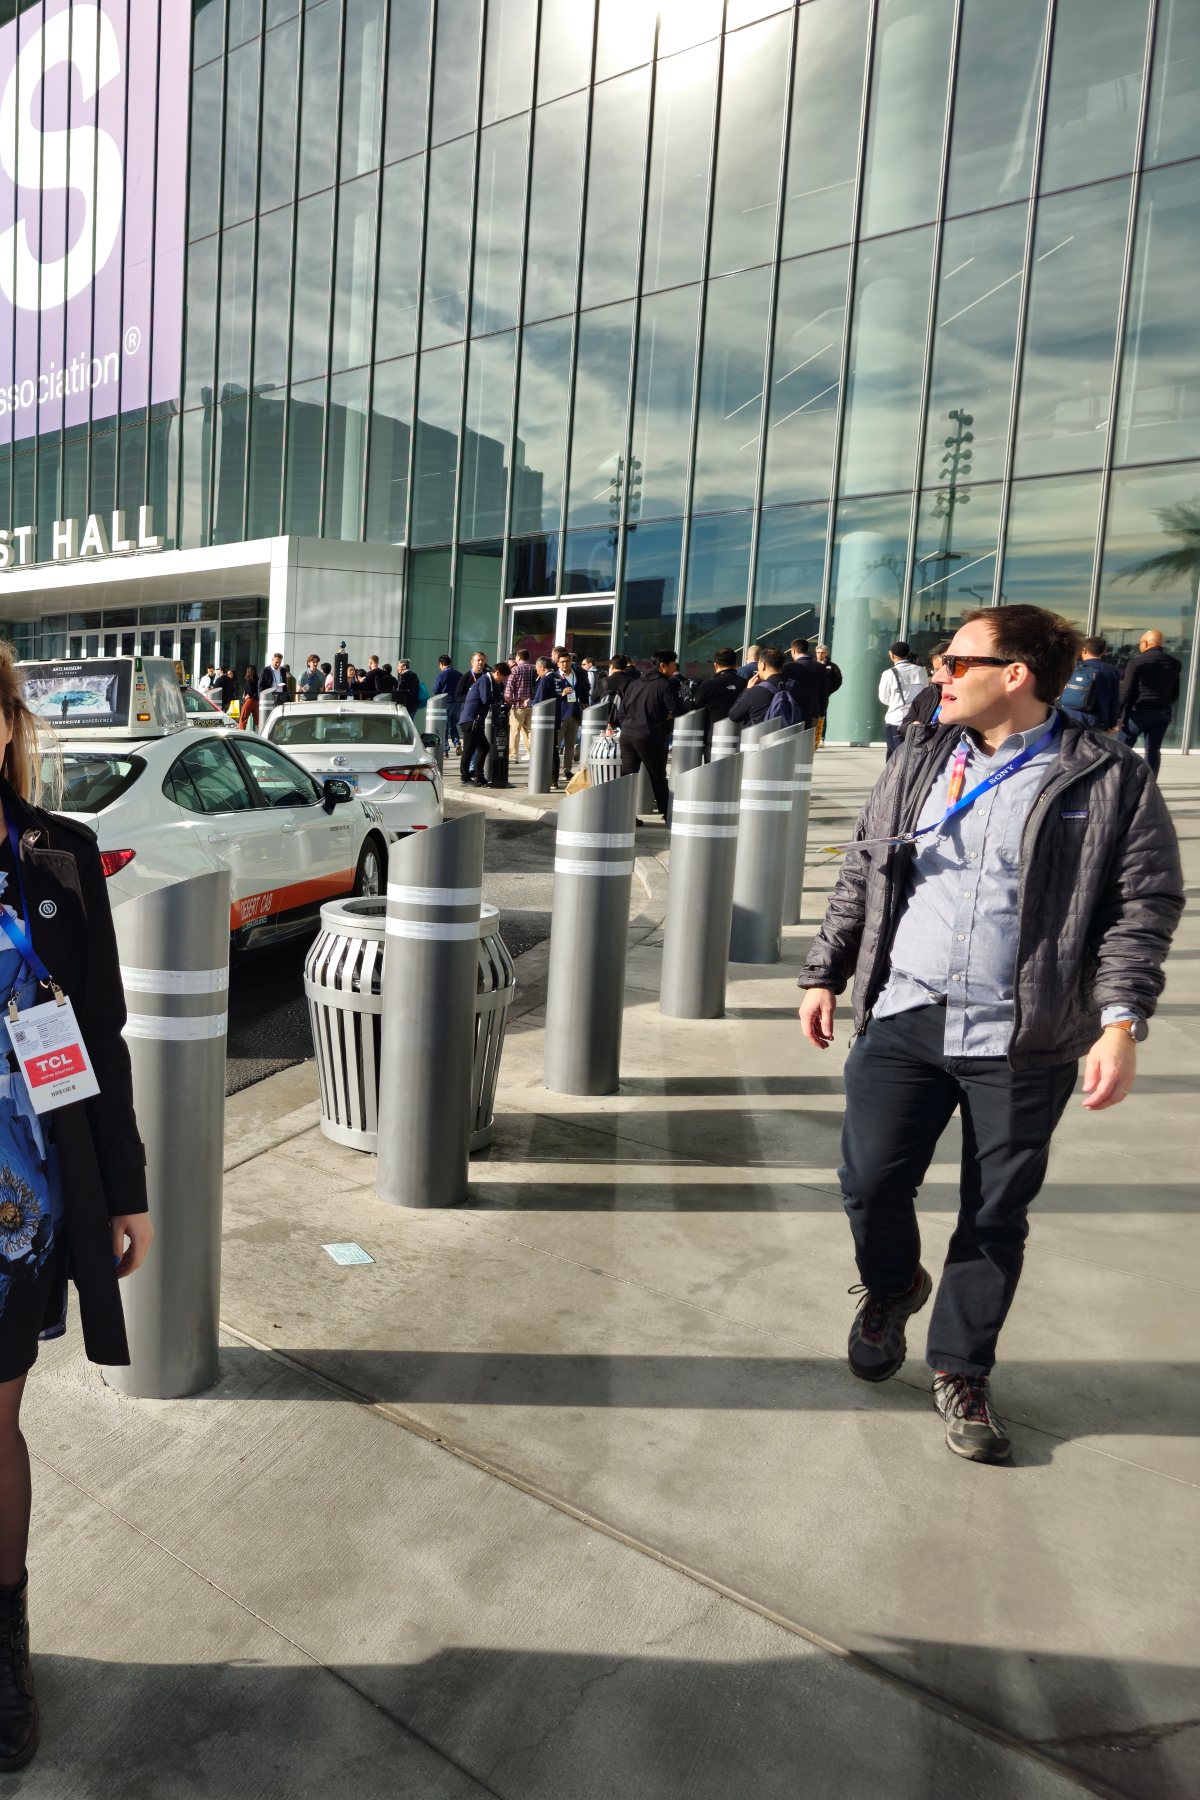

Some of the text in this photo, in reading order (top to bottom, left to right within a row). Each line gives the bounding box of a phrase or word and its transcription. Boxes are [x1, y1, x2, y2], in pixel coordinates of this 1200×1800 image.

[52, 505, 163, 560] HALL
[988, 764, 1014, 785] SONY
[260, 893, 273, 913] CAB
[36, 1053, 73, 1072] TCL
